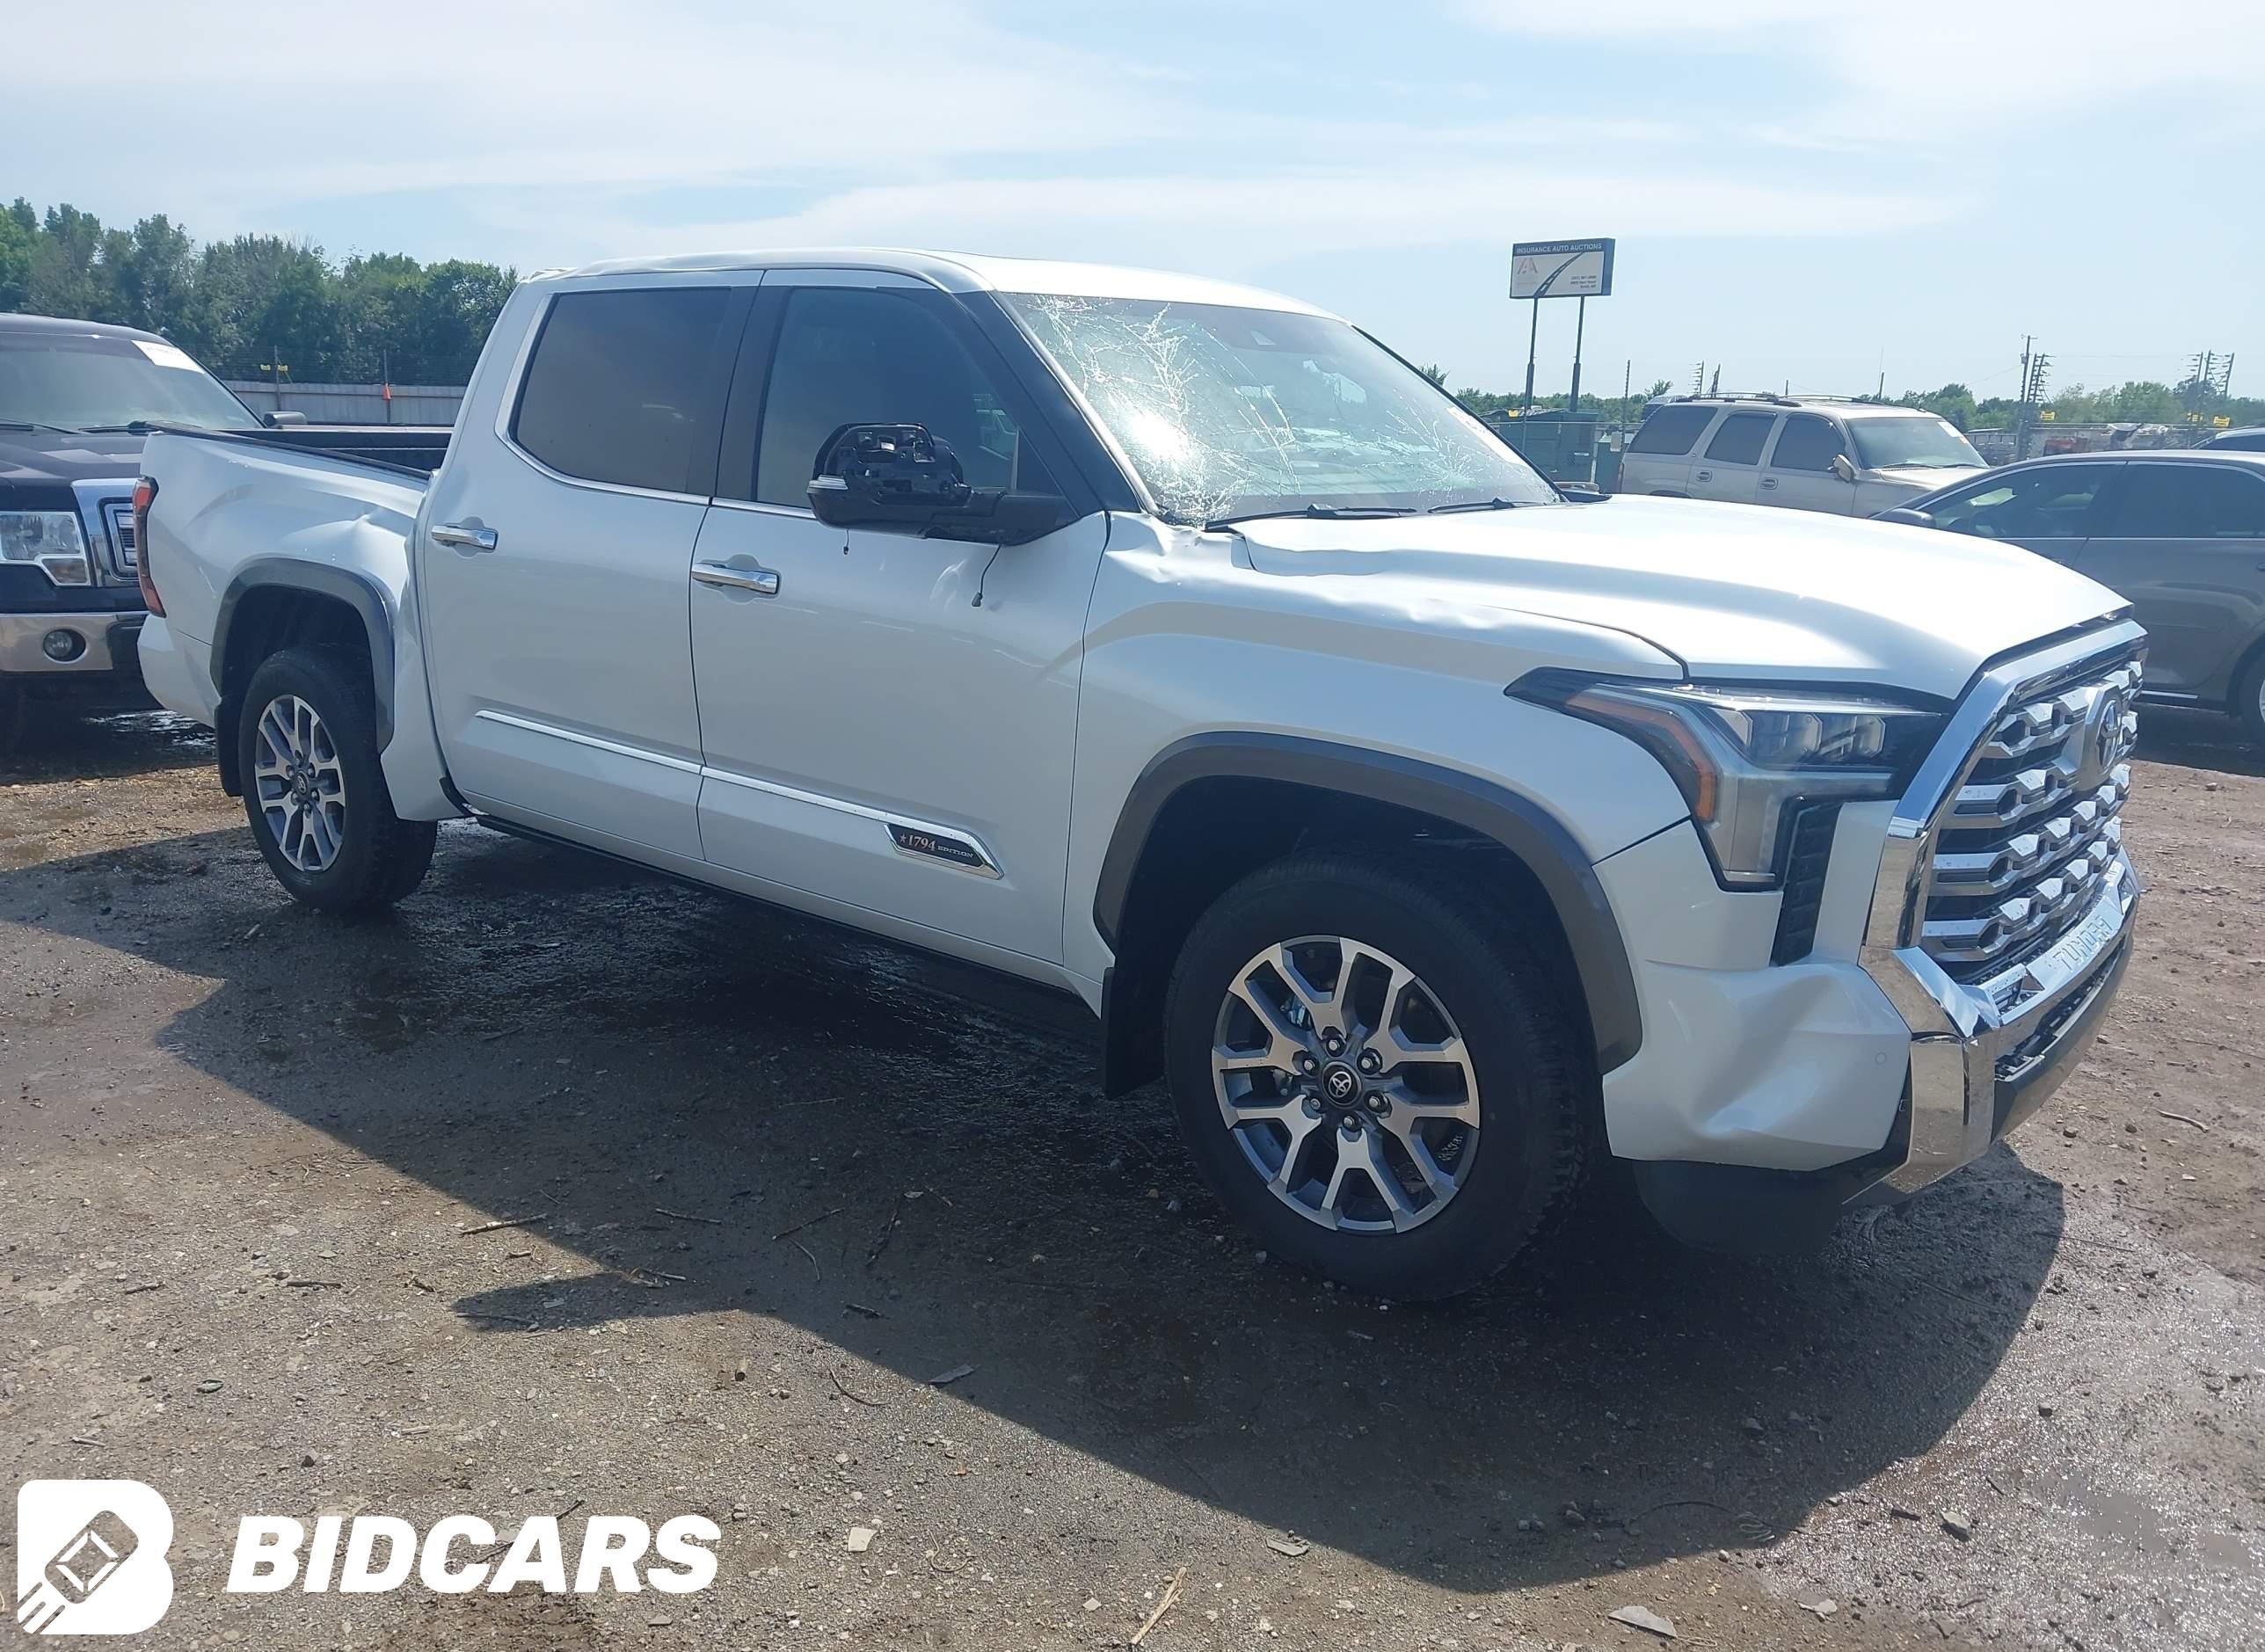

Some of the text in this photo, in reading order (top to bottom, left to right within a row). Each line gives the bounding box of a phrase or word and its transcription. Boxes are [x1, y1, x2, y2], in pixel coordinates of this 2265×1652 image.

[1516, 245, 1552, 254] INSURANCE
[908, 834, 973, 859] 1794 EDITION
